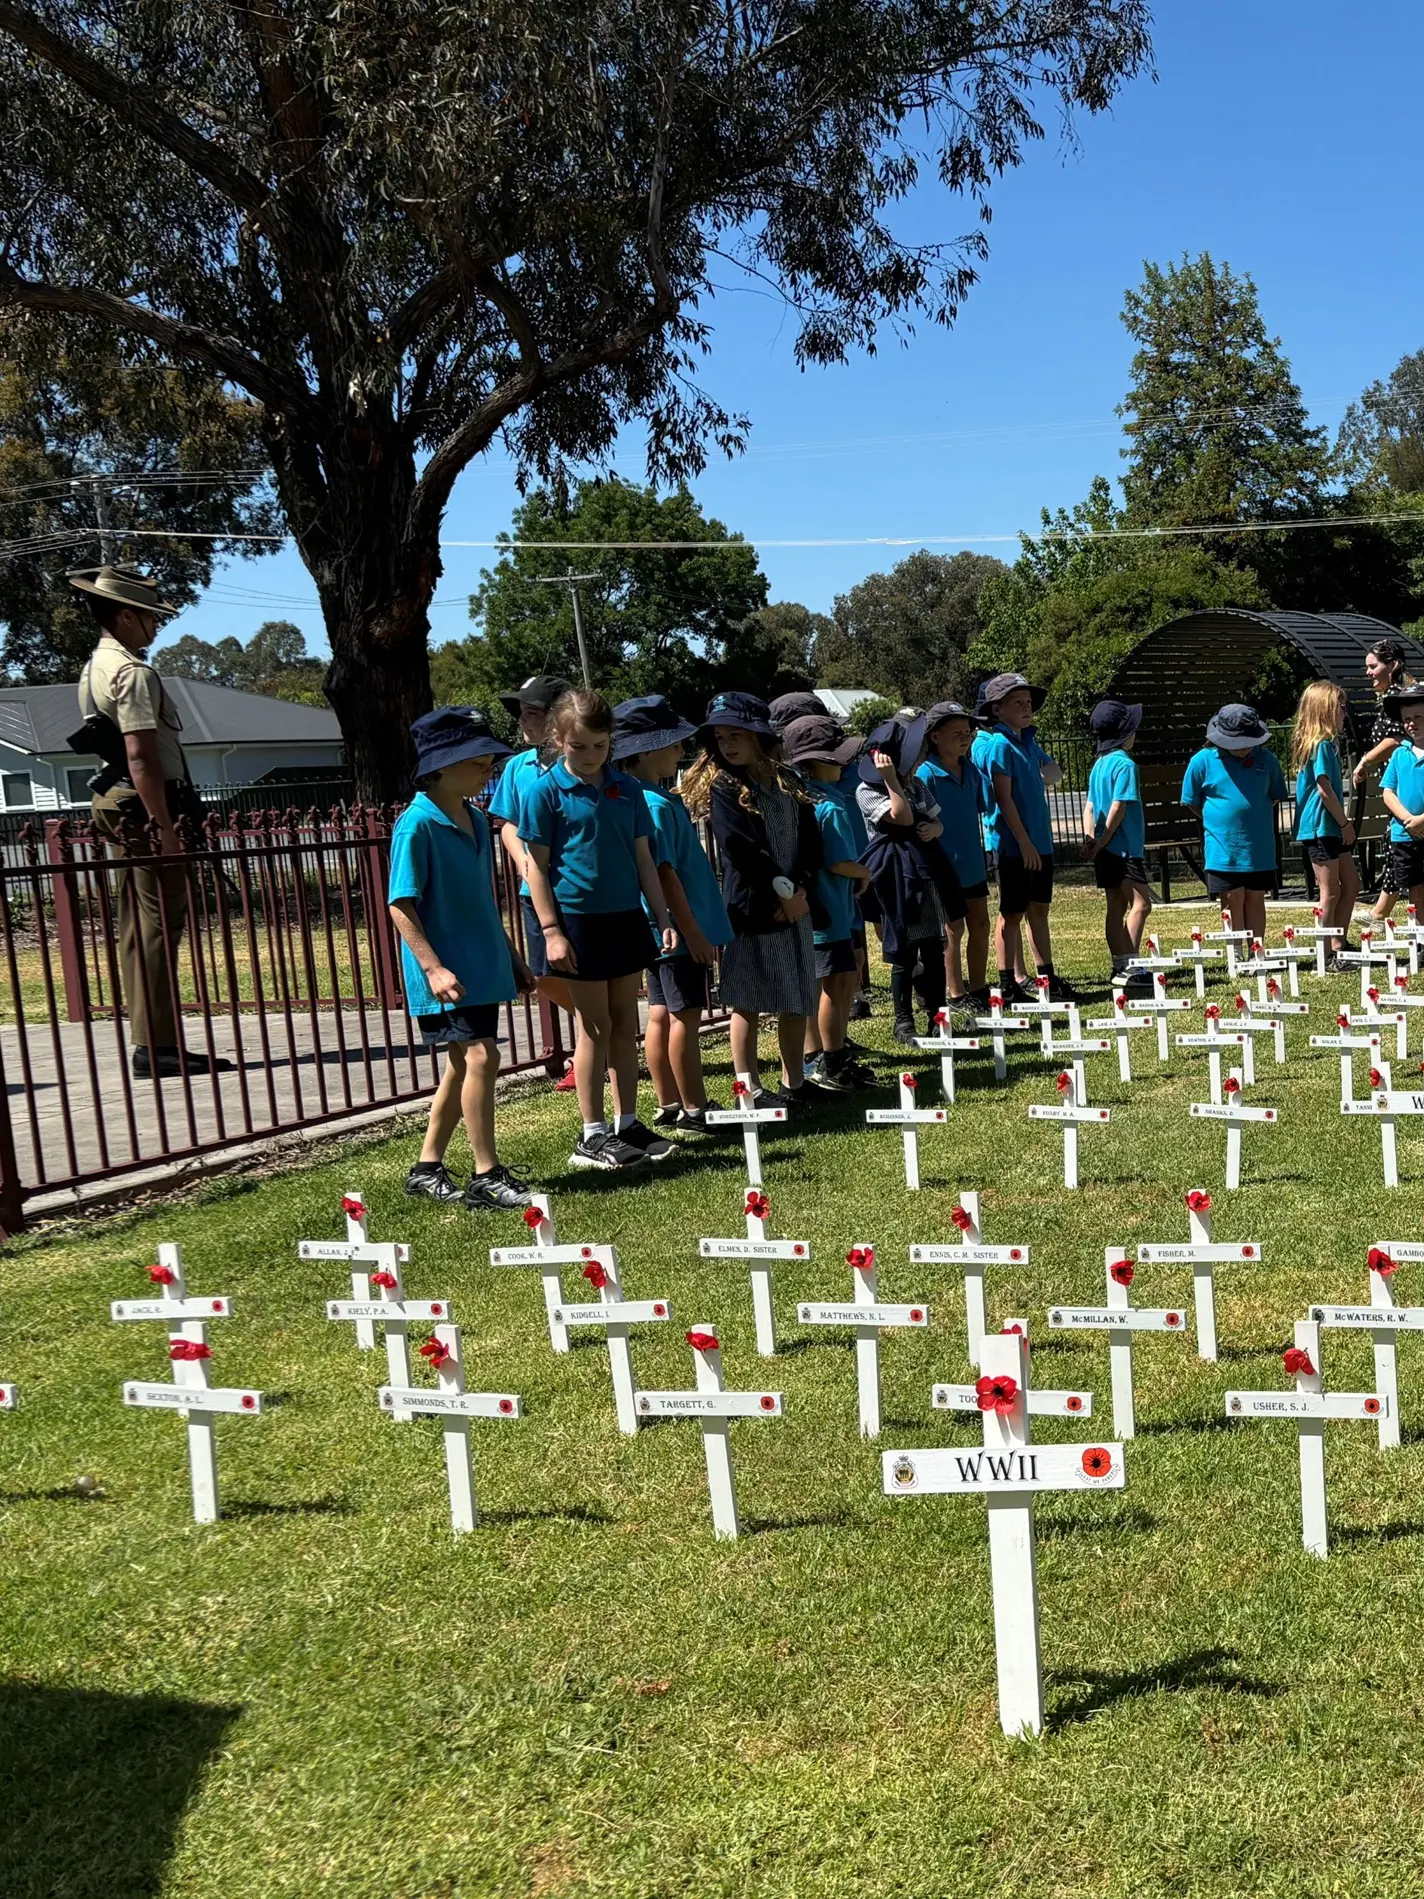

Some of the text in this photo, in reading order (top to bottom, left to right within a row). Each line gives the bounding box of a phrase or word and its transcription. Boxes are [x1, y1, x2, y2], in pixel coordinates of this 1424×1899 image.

[718, 1245, 743, 1254] ELMES,
[1158, 1250, 1186, 1258] FISHER,
[930, 1251, 953, 1259] ENNIS,
[347, 1307, 372, 1316] KIELY,
[571, 1311, 604, 1320] KIDGELL,
[820, 1311, 867, 1321] MATTHEWS,
[1072, 1315, 1128, 1324] McMILLAN, W.
[1335, 1312, 1408, 1322] McWATERS, R. W.
[402, 1397, 469, 1409] SIMMONDS, T. R.
[660, 1400, 716, 1410] TARGETT, G.
[1253, 1402, 1309, 1412] USHER, S. J.
[955, 1450, 1042, 1482] WWII
